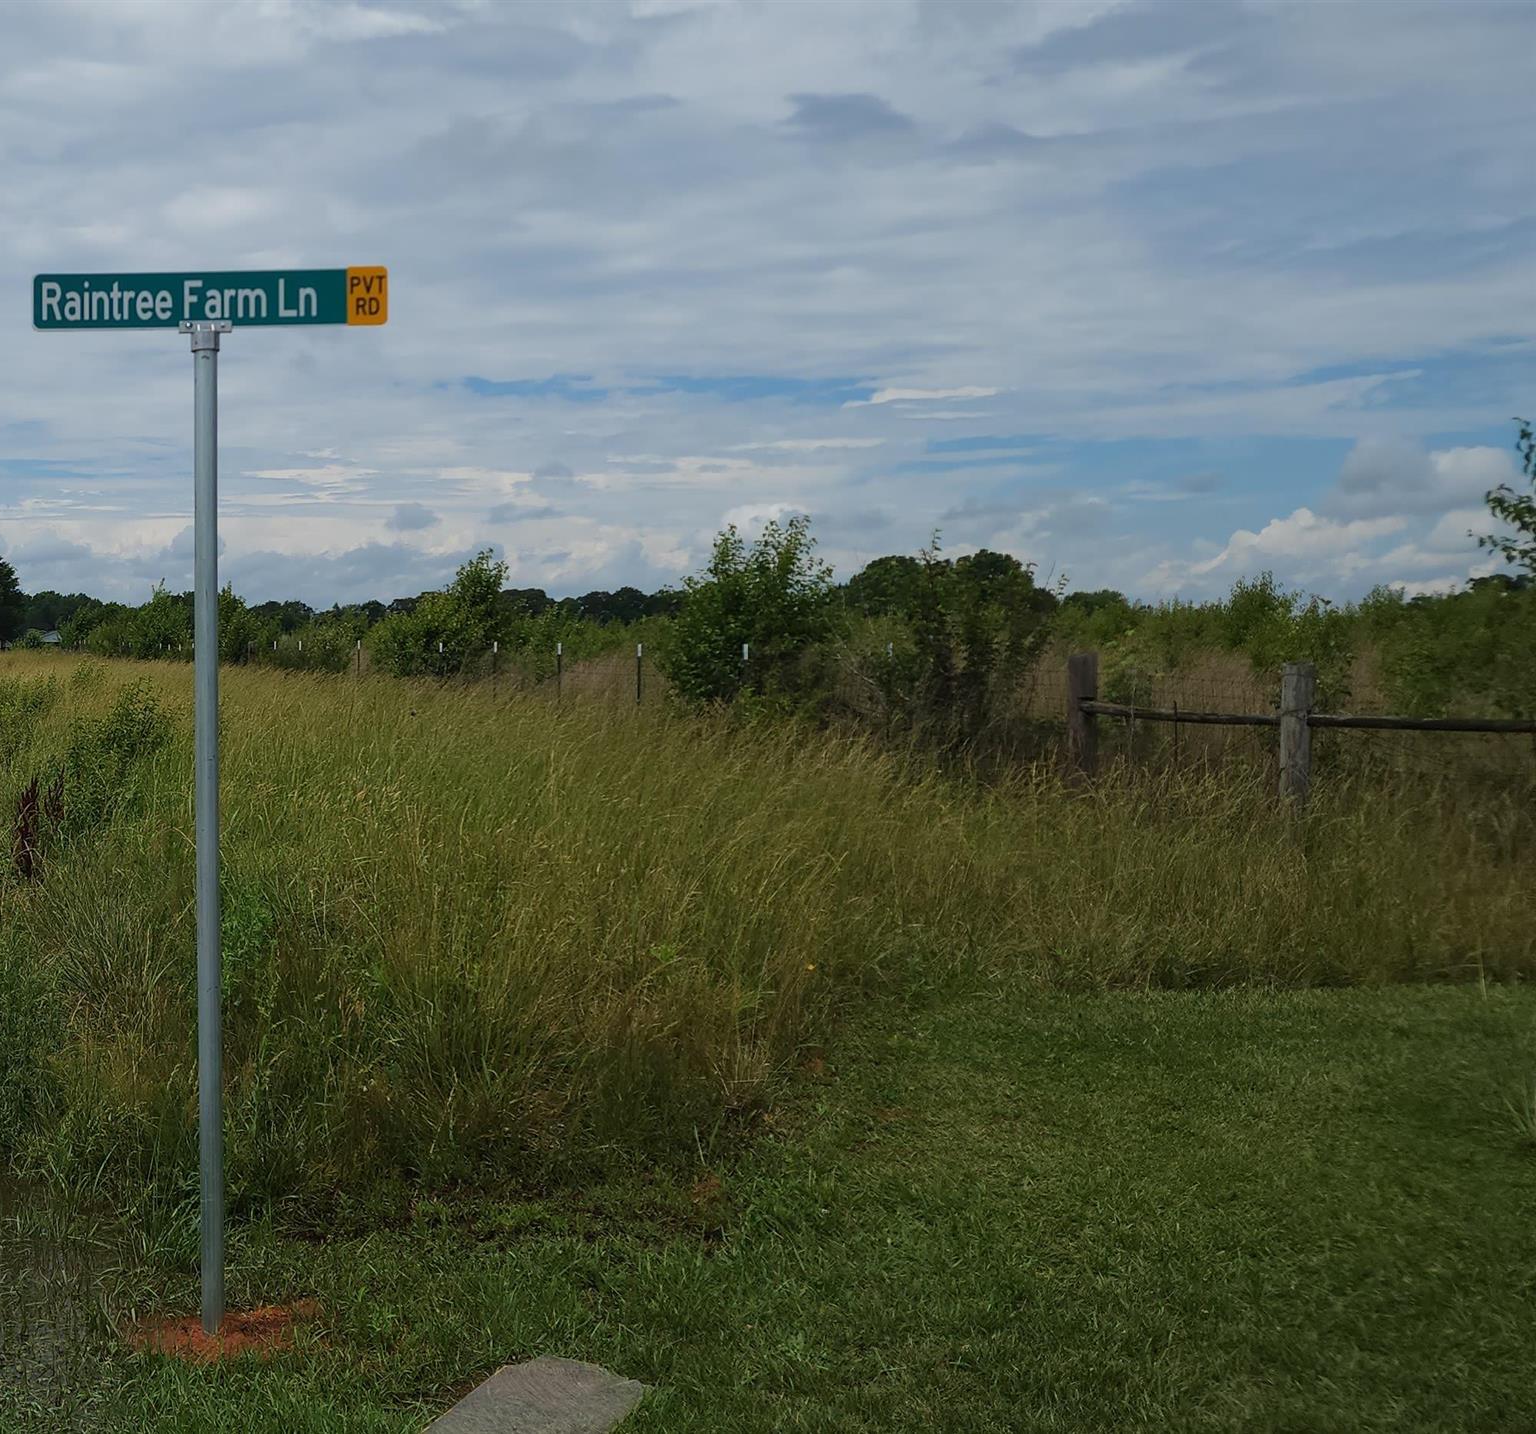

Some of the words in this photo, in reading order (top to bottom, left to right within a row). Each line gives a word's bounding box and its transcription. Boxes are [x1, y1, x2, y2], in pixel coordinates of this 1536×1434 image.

[349, 275, 386, 294] PVT
[41, 281, 173, 321] Raintree
[183, 279, 267, 319] Farm
[278, 278, 318, 317] Ln
[355, 297, 380, 316] RD
